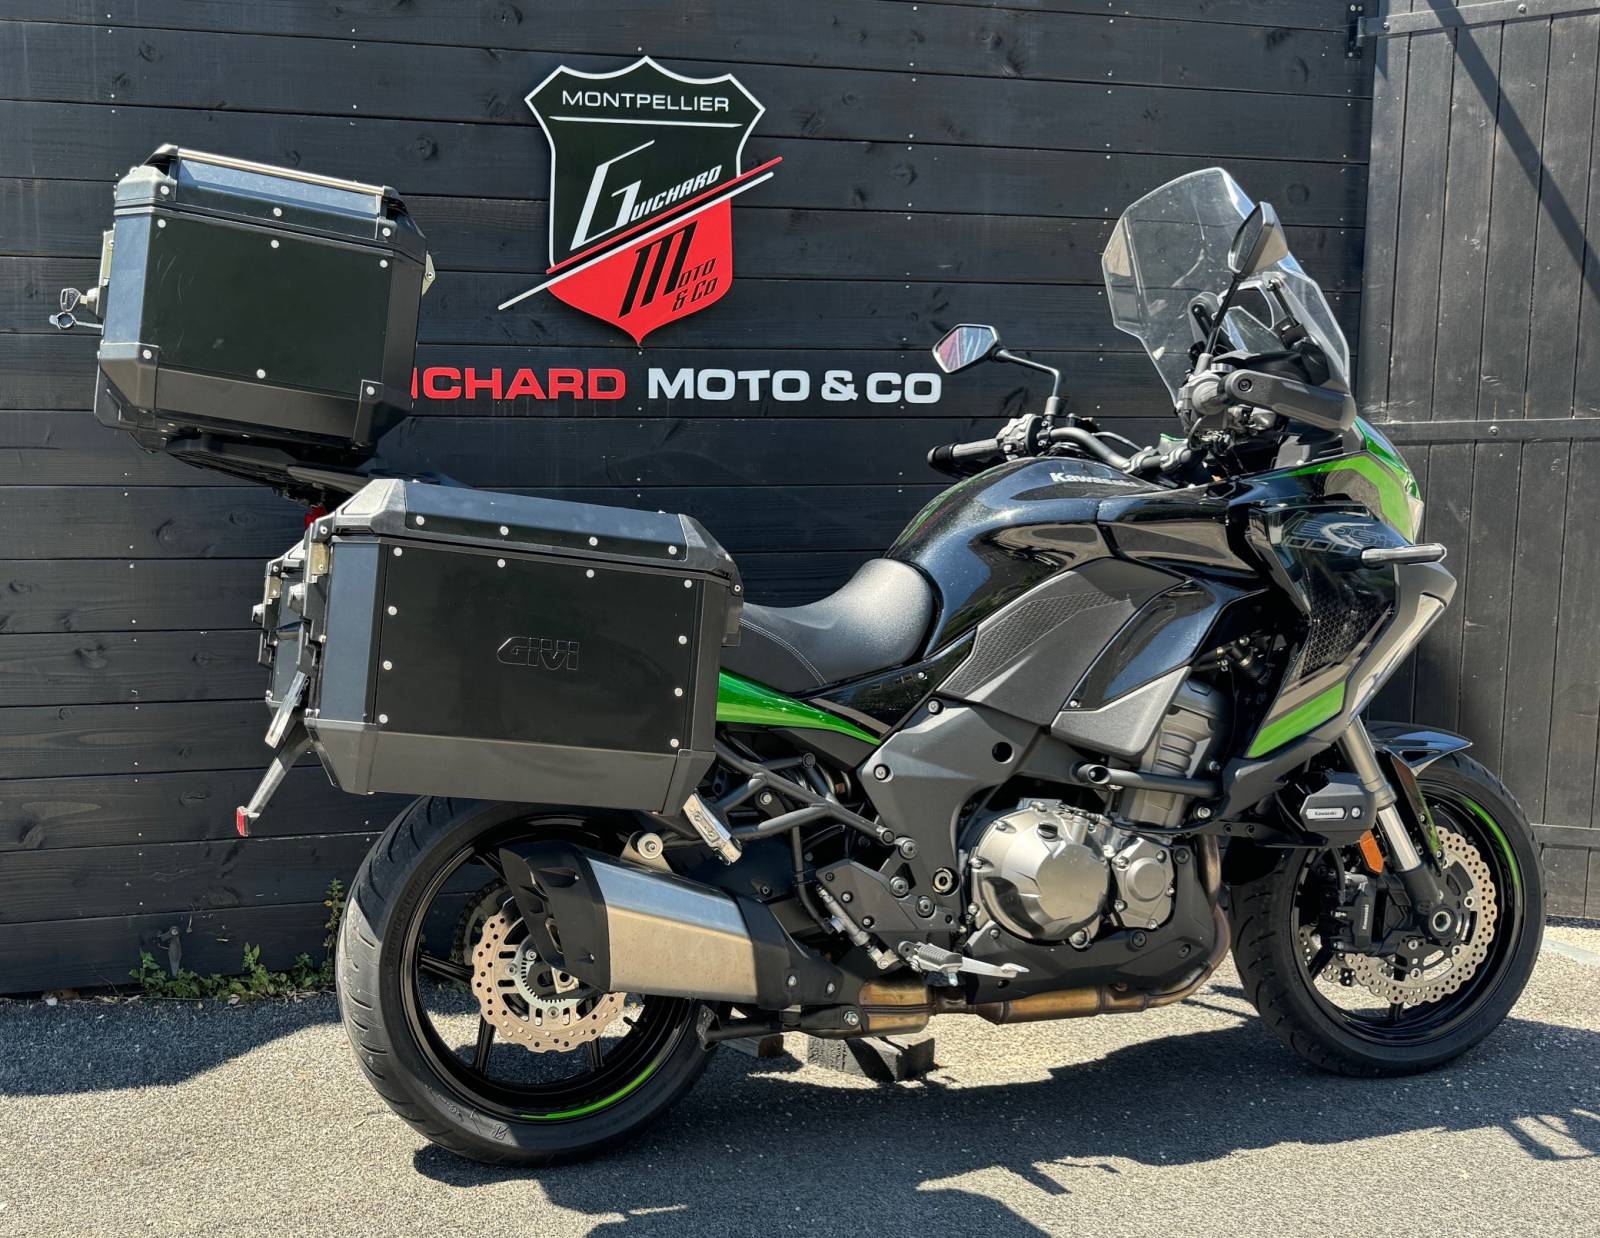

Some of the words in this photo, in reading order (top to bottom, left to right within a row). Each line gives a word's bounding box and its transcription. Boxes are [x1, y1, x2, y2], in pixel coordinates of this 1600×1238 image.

[562, 90, 730, 112] MONTPELLIER
[570, 139, 723, 251] GUICHARD
[671, 289, 688, 313] &
[647, 368, 811, 401] MOTO
[821, 369, 859, 401] &
[866, 372, 942, 403] CO
[1049, 472, 1140, 488] Kawasaki
[496, 636, 580, 671] GIVI
